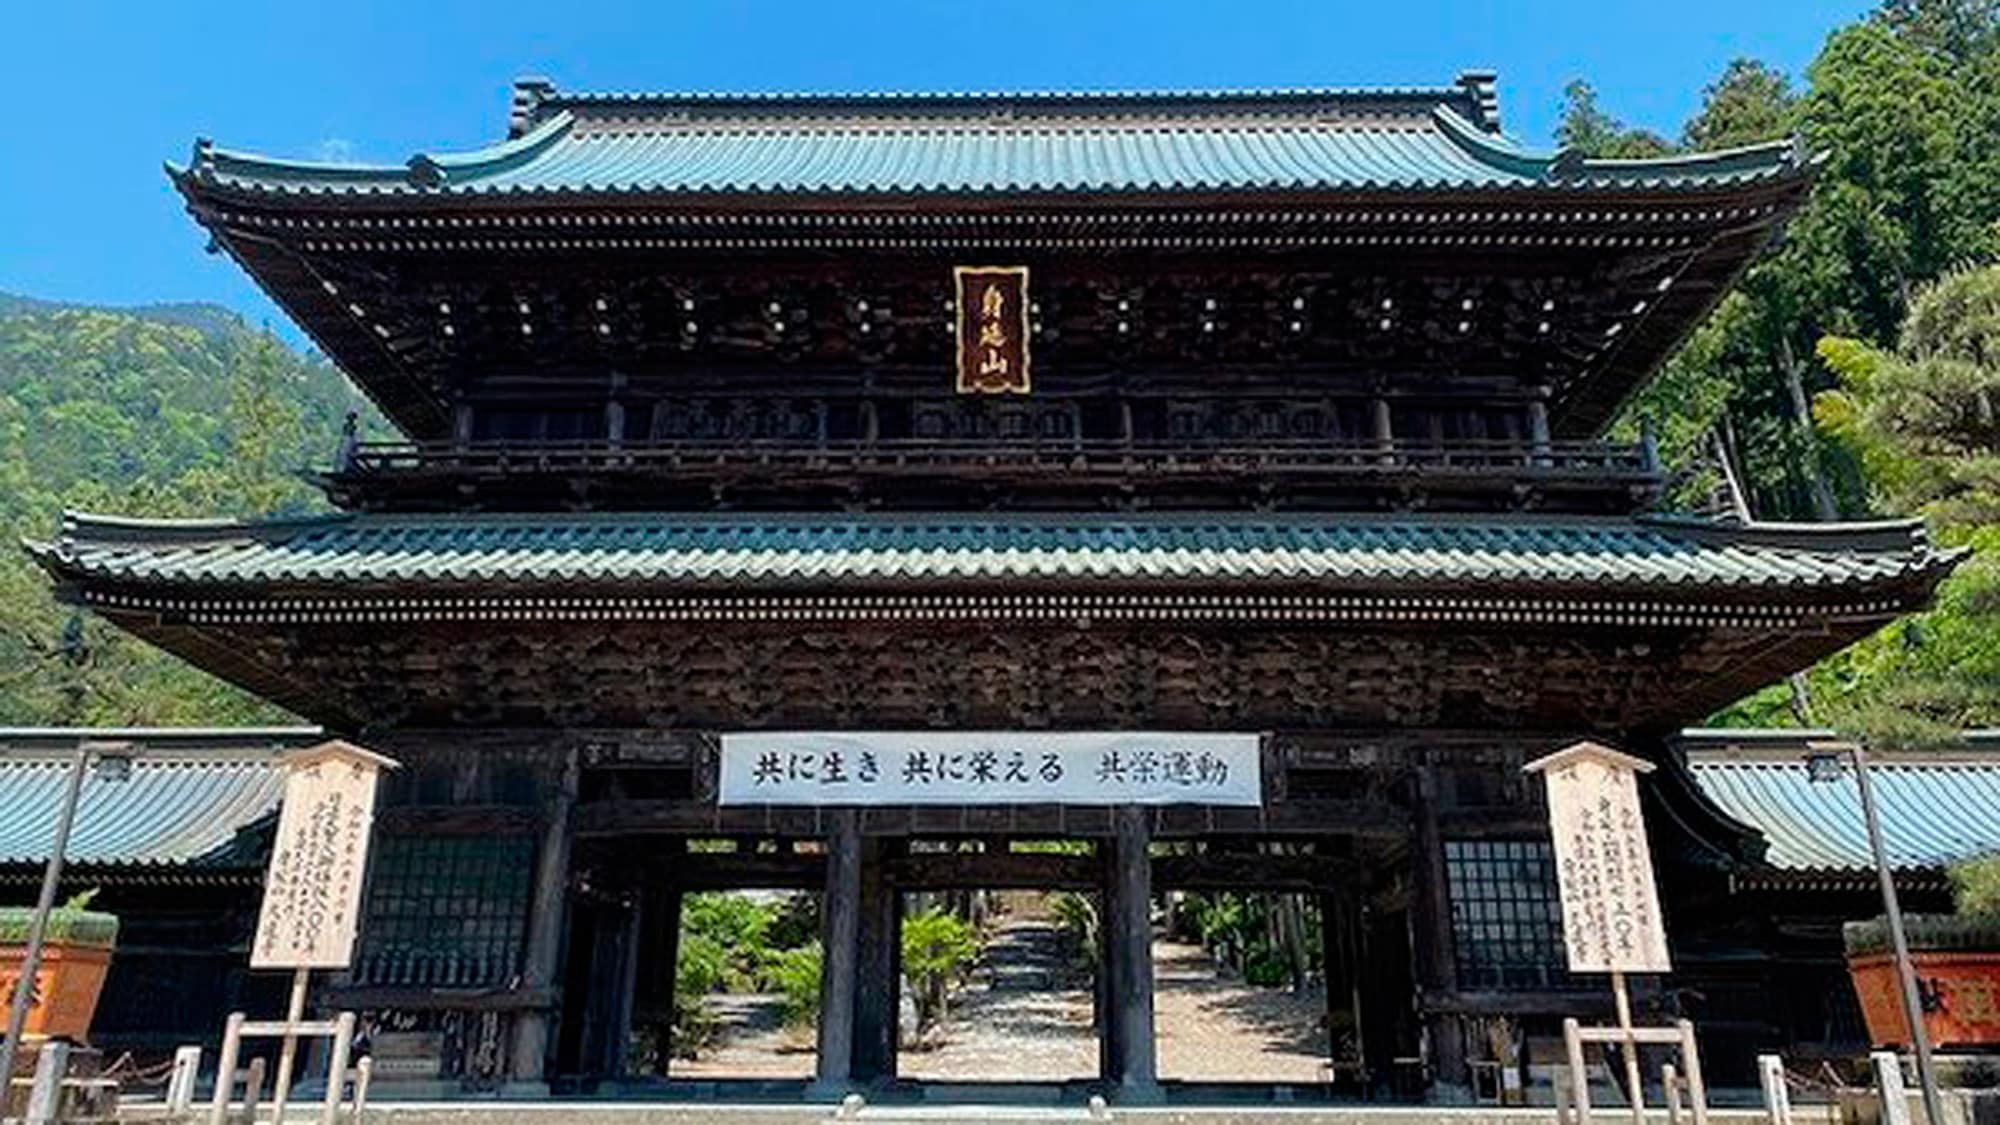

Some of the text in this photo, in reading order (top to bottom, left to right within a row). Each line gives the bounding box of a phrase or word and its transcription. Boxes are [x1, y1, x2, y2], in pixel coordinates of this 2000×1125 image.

[752, 750, 1228, 786] 共に生き 共に栄える 共栄運動
